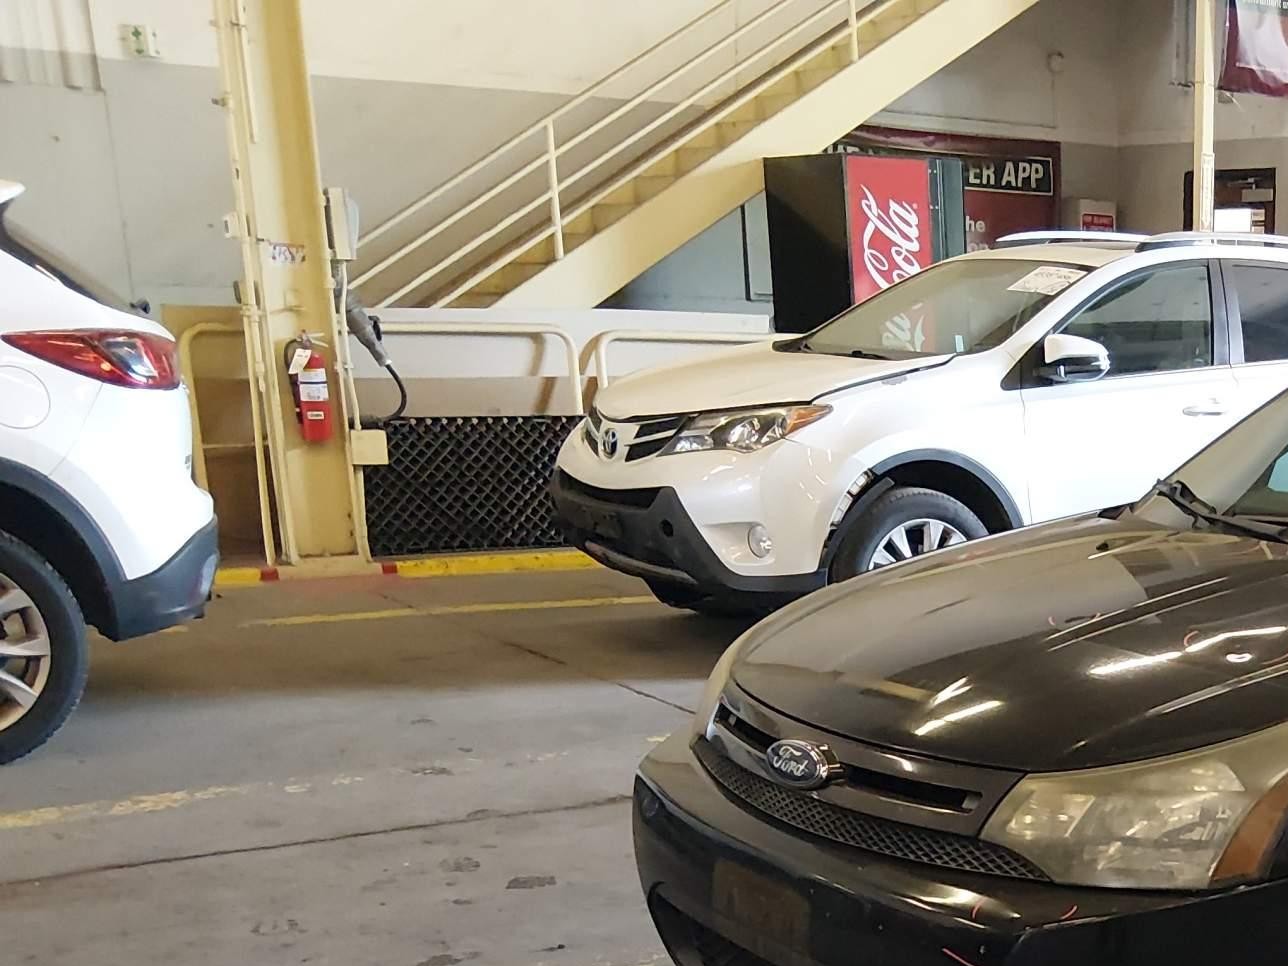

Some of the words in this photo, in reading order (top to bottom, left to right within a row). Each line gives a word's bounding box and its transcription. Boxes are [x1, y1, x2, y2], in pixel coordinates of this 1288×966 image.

[968, 163, 995, 185] ER
[1001, 161, 1044, 188] APP
[966, 215, 986, 233] he
[773, 745, 809, 777] Ford
